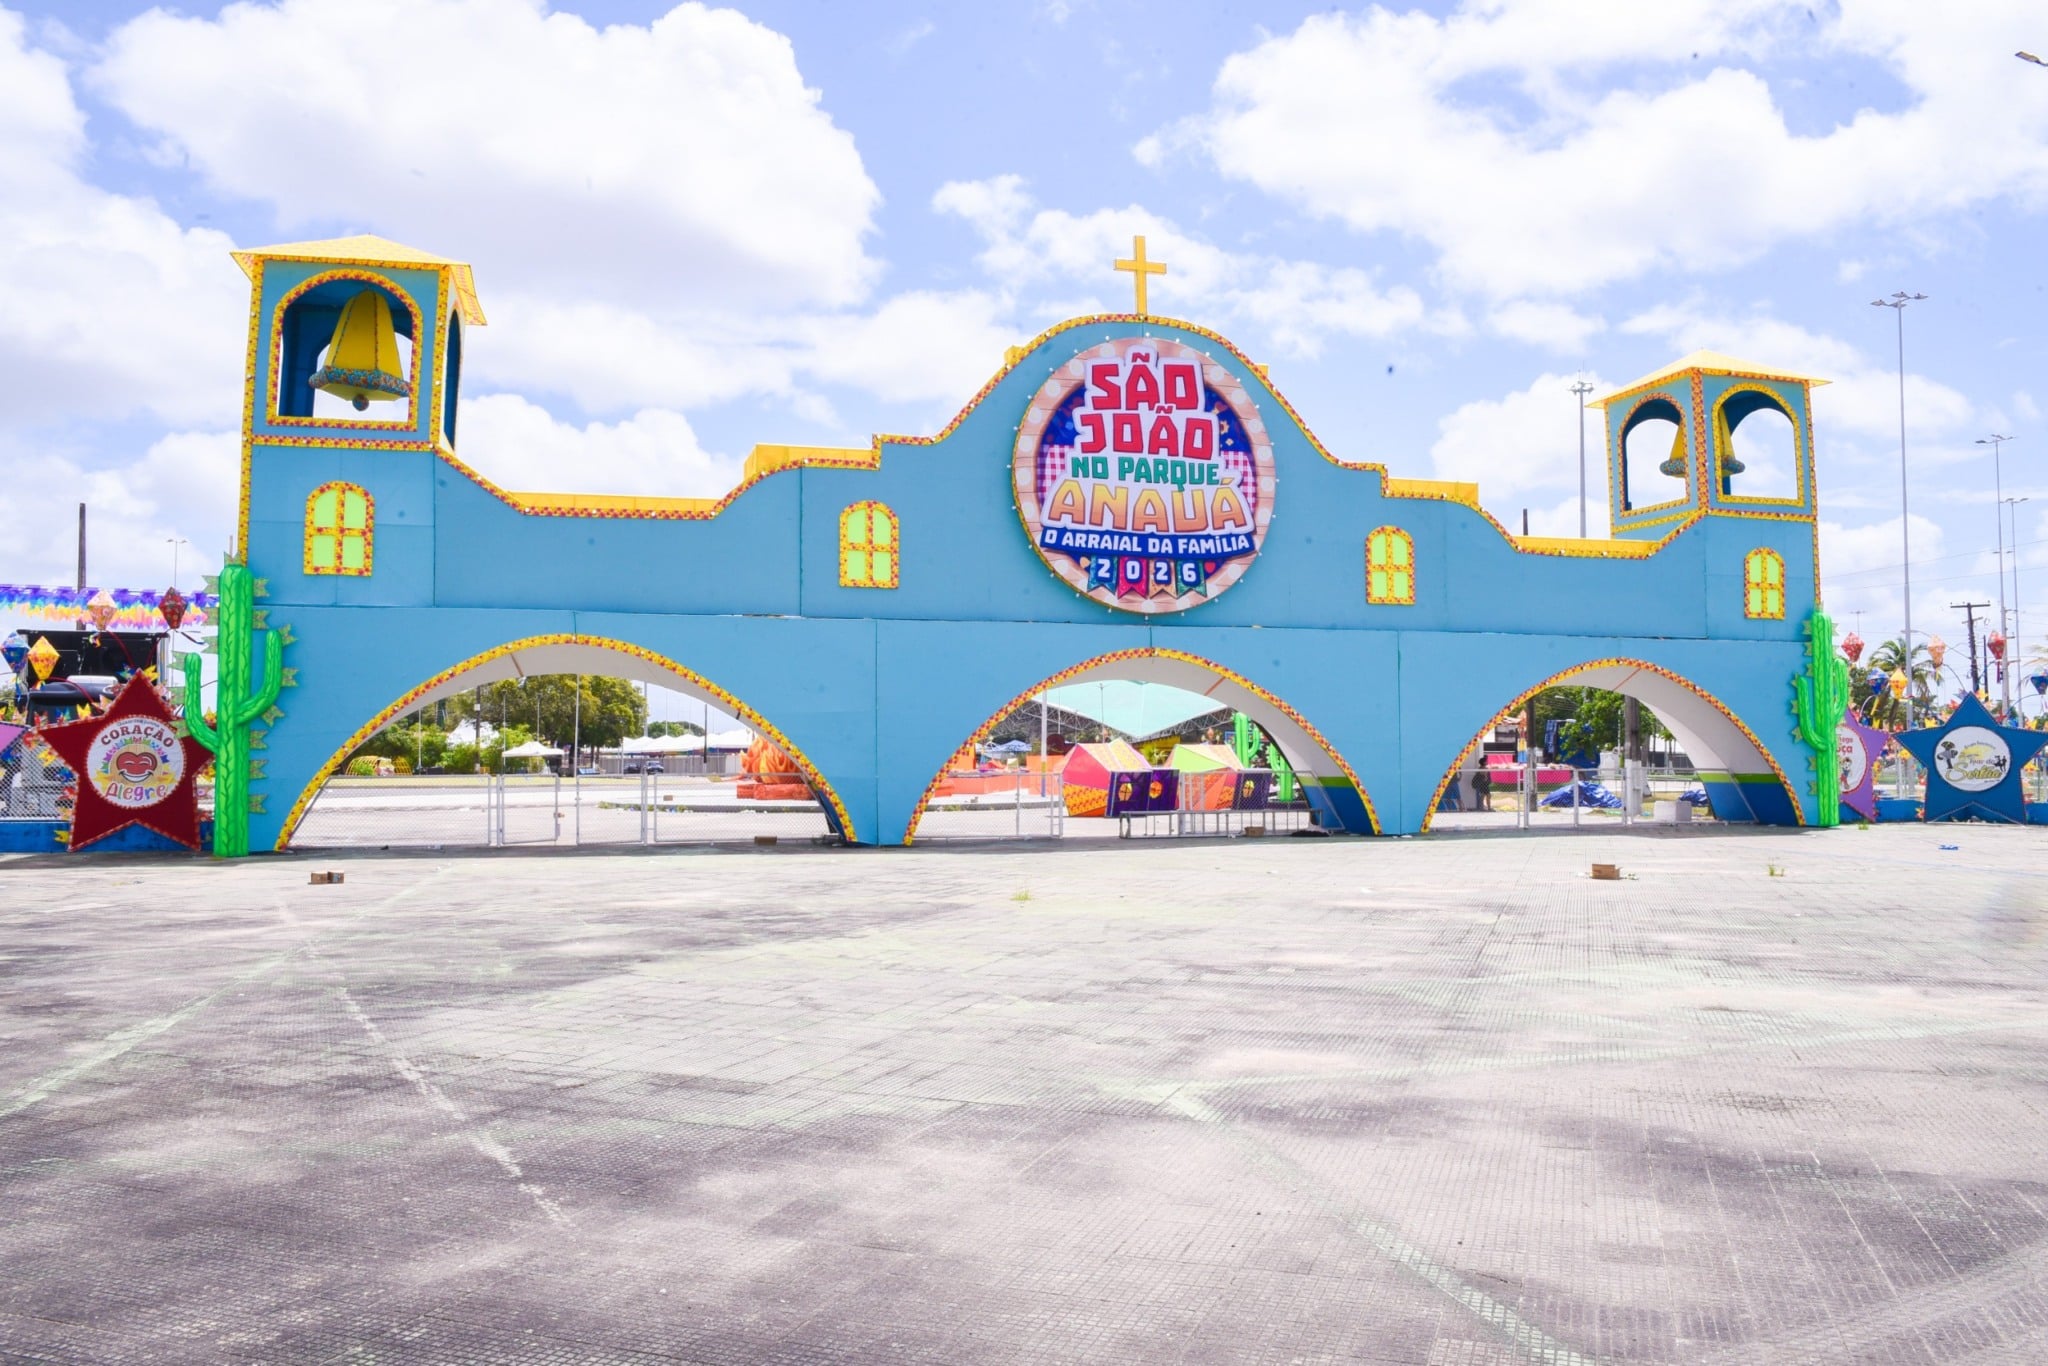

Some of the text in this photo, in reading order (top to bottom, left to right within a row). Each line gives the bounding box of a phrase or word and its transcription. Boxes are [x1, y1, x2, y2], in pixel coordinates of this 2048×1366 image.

[1091, 352, 1199, 411] SÃO
[1080, 405, 1214, 460] JOÃO
[1071, 456, 1220, 492] NO PARQUE
[1047, 477, 1247, 533] ANAUÁ
[1045, 530, 1250, 554] O ARRAIAL DA FAMÍLIA
[1097, 558, 1197, 582] 2026
[101, 725, 174, 748] CORAÇÃO
[105, 782, 167, 801] Alegre
